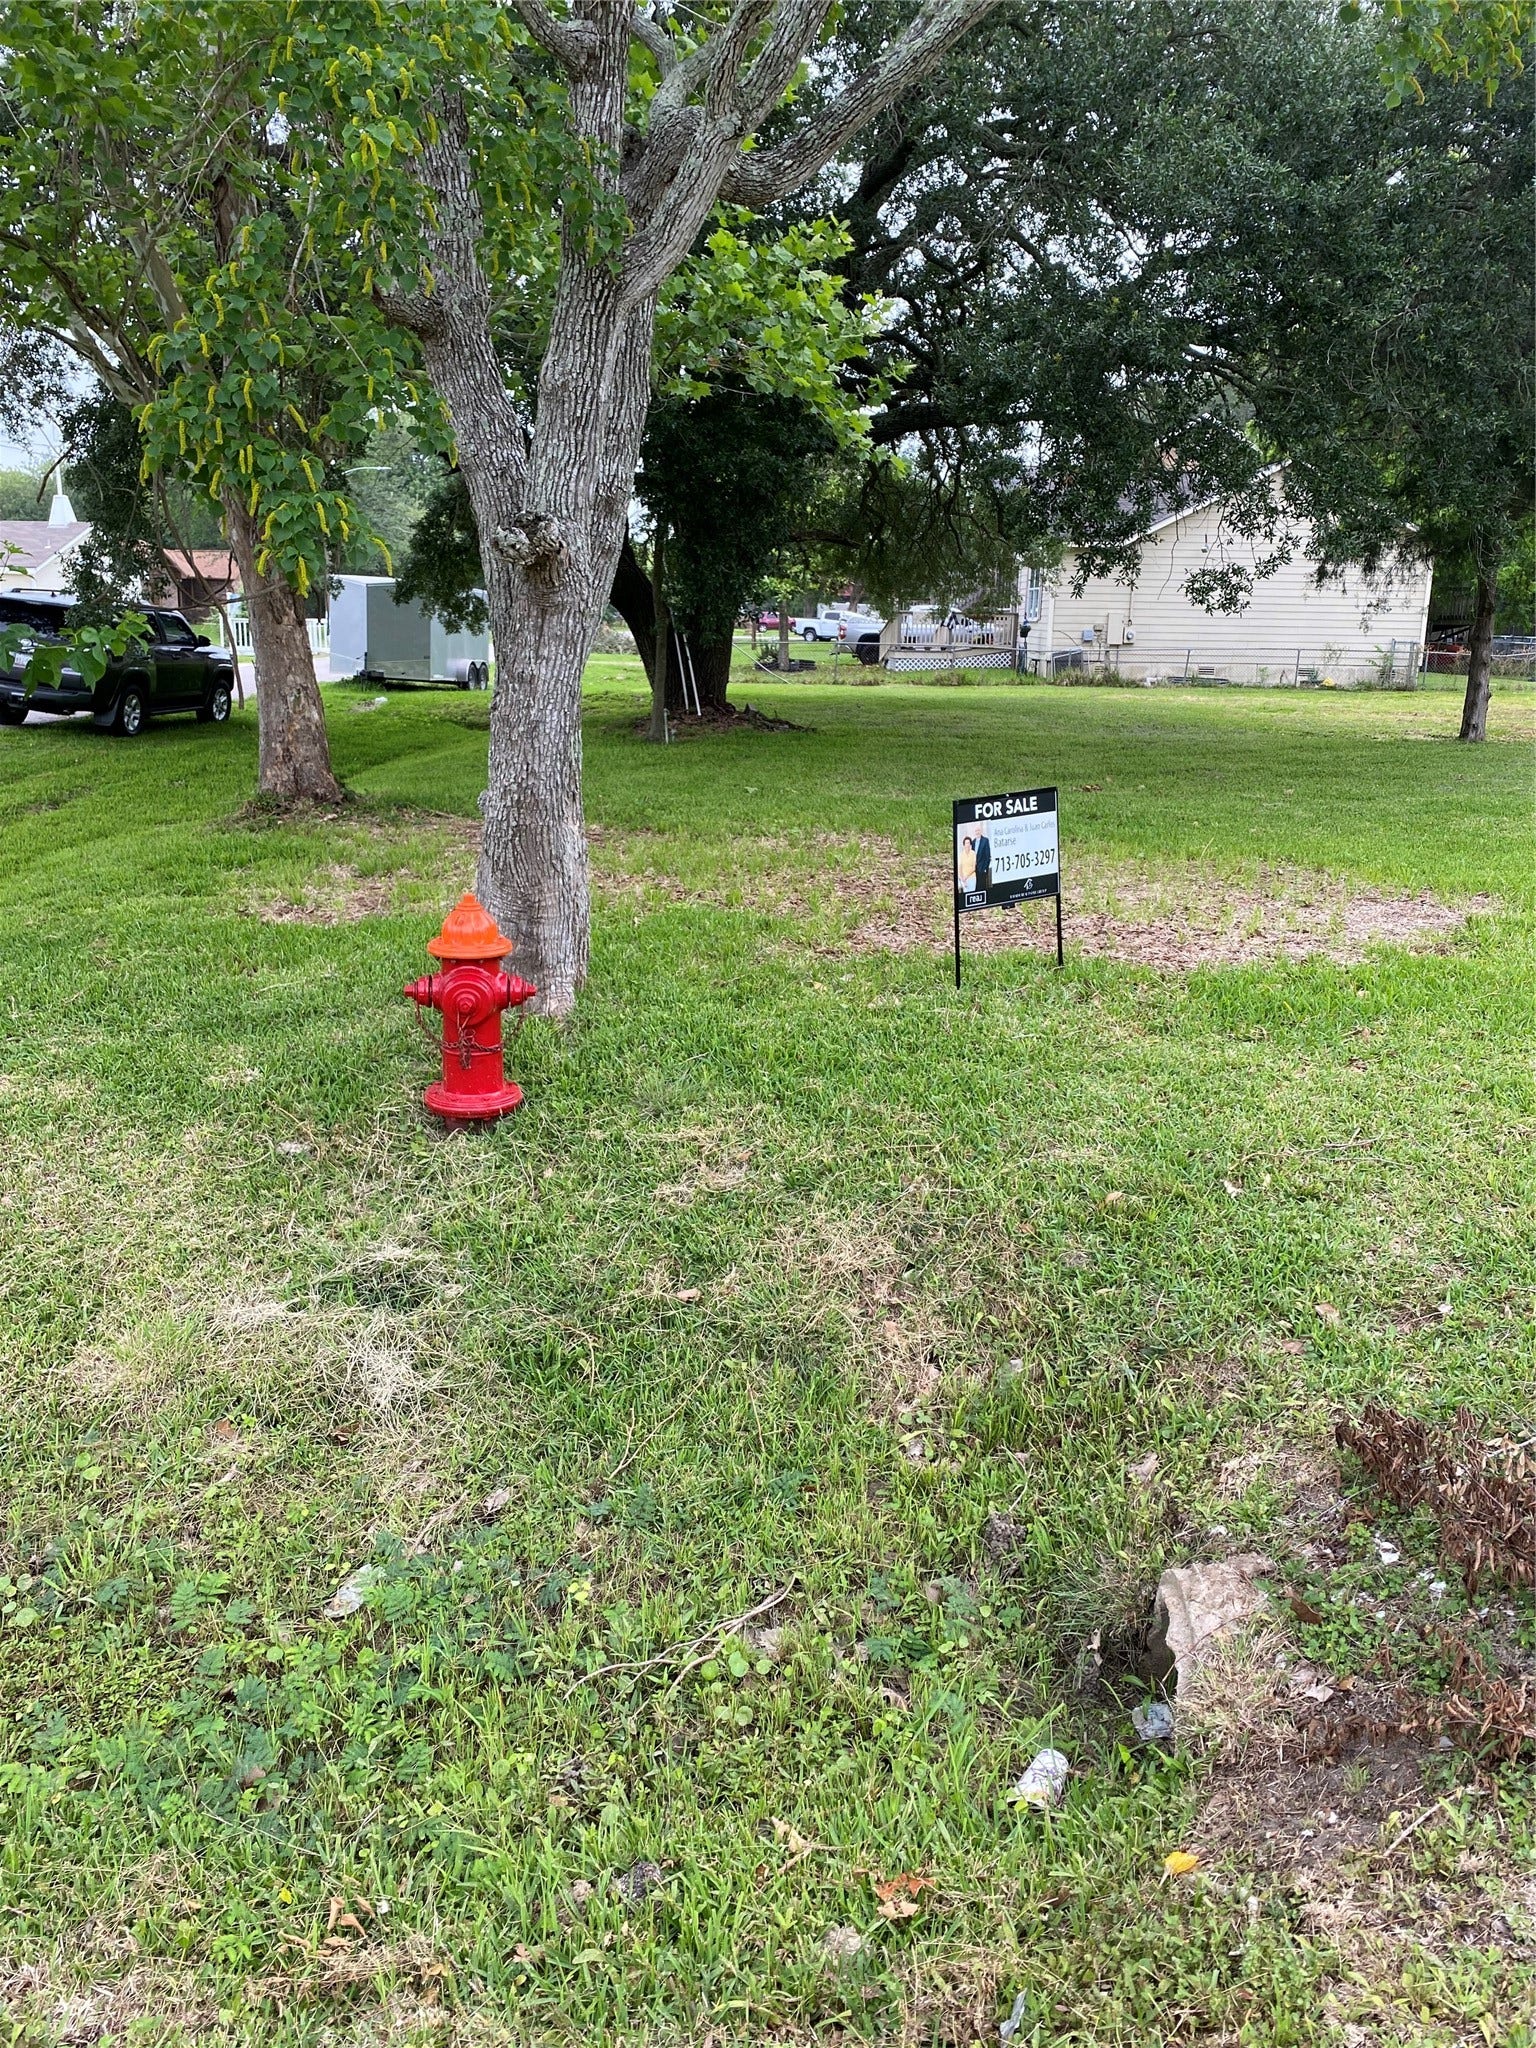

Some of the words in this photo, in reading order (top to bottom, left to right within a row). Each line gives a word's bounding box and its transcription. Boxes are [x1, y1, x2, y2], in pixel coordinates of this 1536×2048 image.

[974, 801, 1002, 819] FOR
[1005, 796, 1038, 815] SALE
[995, 848, 1055, 873] 713-705-3297
